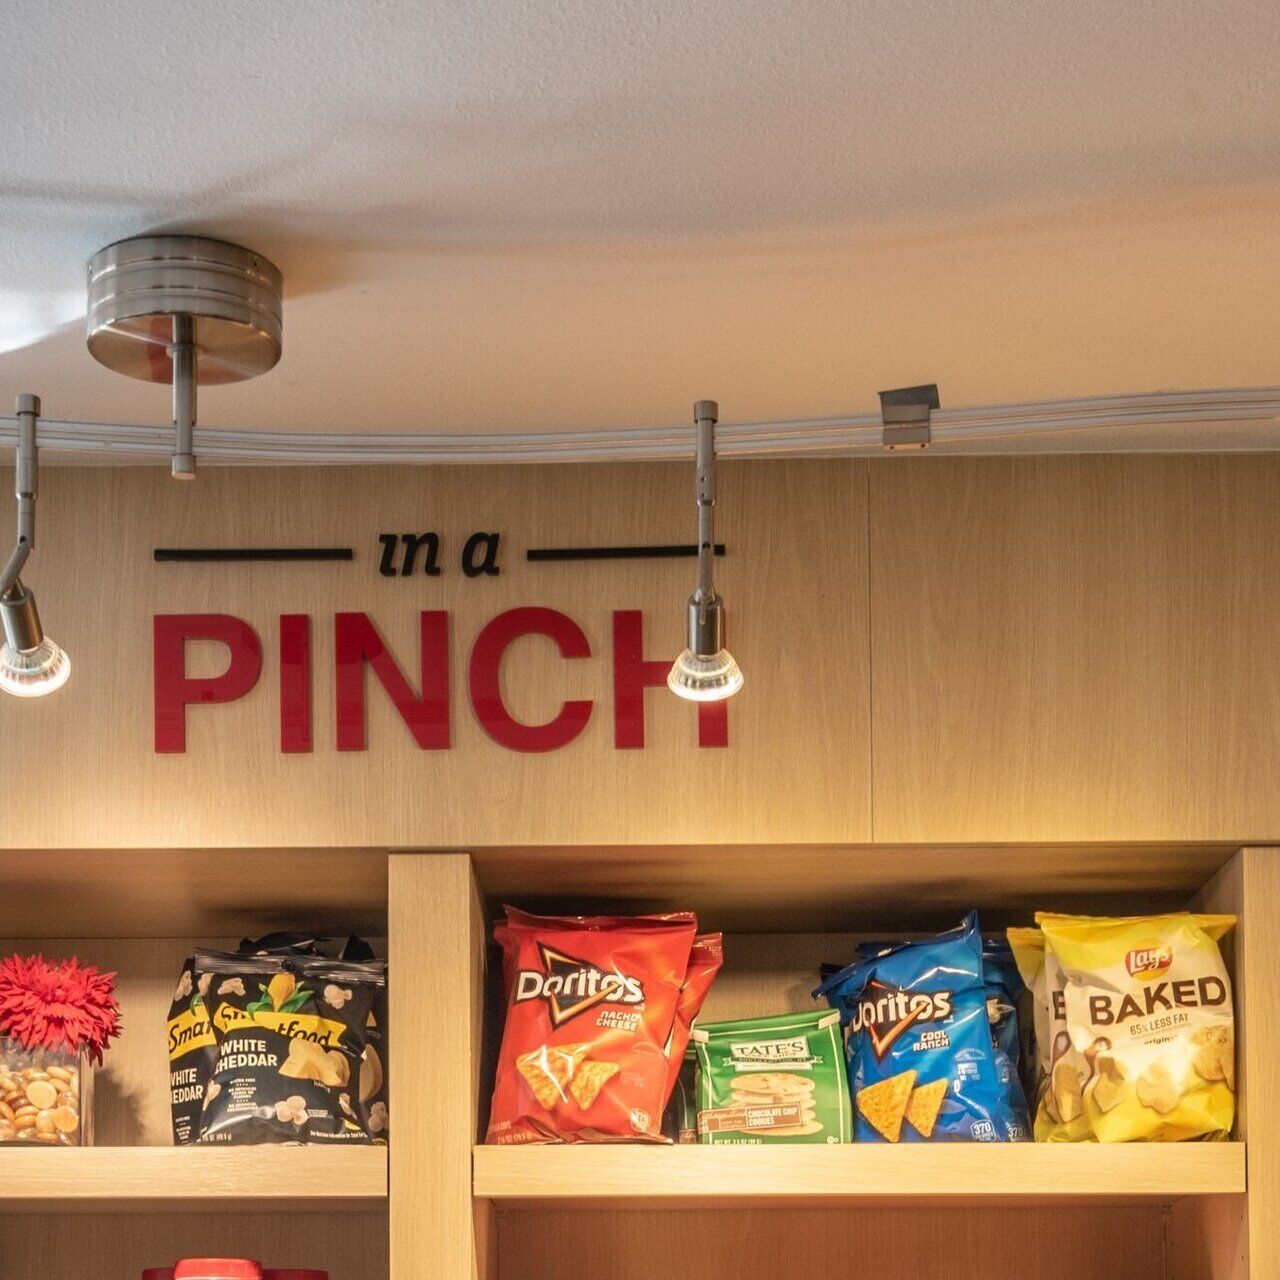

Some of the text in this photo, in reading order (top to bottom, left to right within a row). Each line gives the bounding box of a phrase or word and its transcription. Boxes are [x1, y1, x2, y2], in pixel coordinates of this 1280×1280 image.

[379, 530, 501, 578] in a
[153, 606, 729, 754] PINCH
[515, 969, 645, 1003] Doritos
[1088, 975, 1227, 1026] BAKED
[595, 1019, 638, 1032] CHEESE
[1149, 1017, 1173, 1032] LESS
[1173, 1013, 1189, 1024] FAT
[920, 1029, 948, 1042] COOL
[220, 1038, 267, 1056] WHITE
[735, 1040, 805, 1056] TATE'S
[912, 1039, 950, 1052] RANCH
[748, 1105, 798, 1117] CHOCOLATE CHIP
[748, 1116, 775, 1127] COOKIES
[973, 1121, 992, 1135] 370
